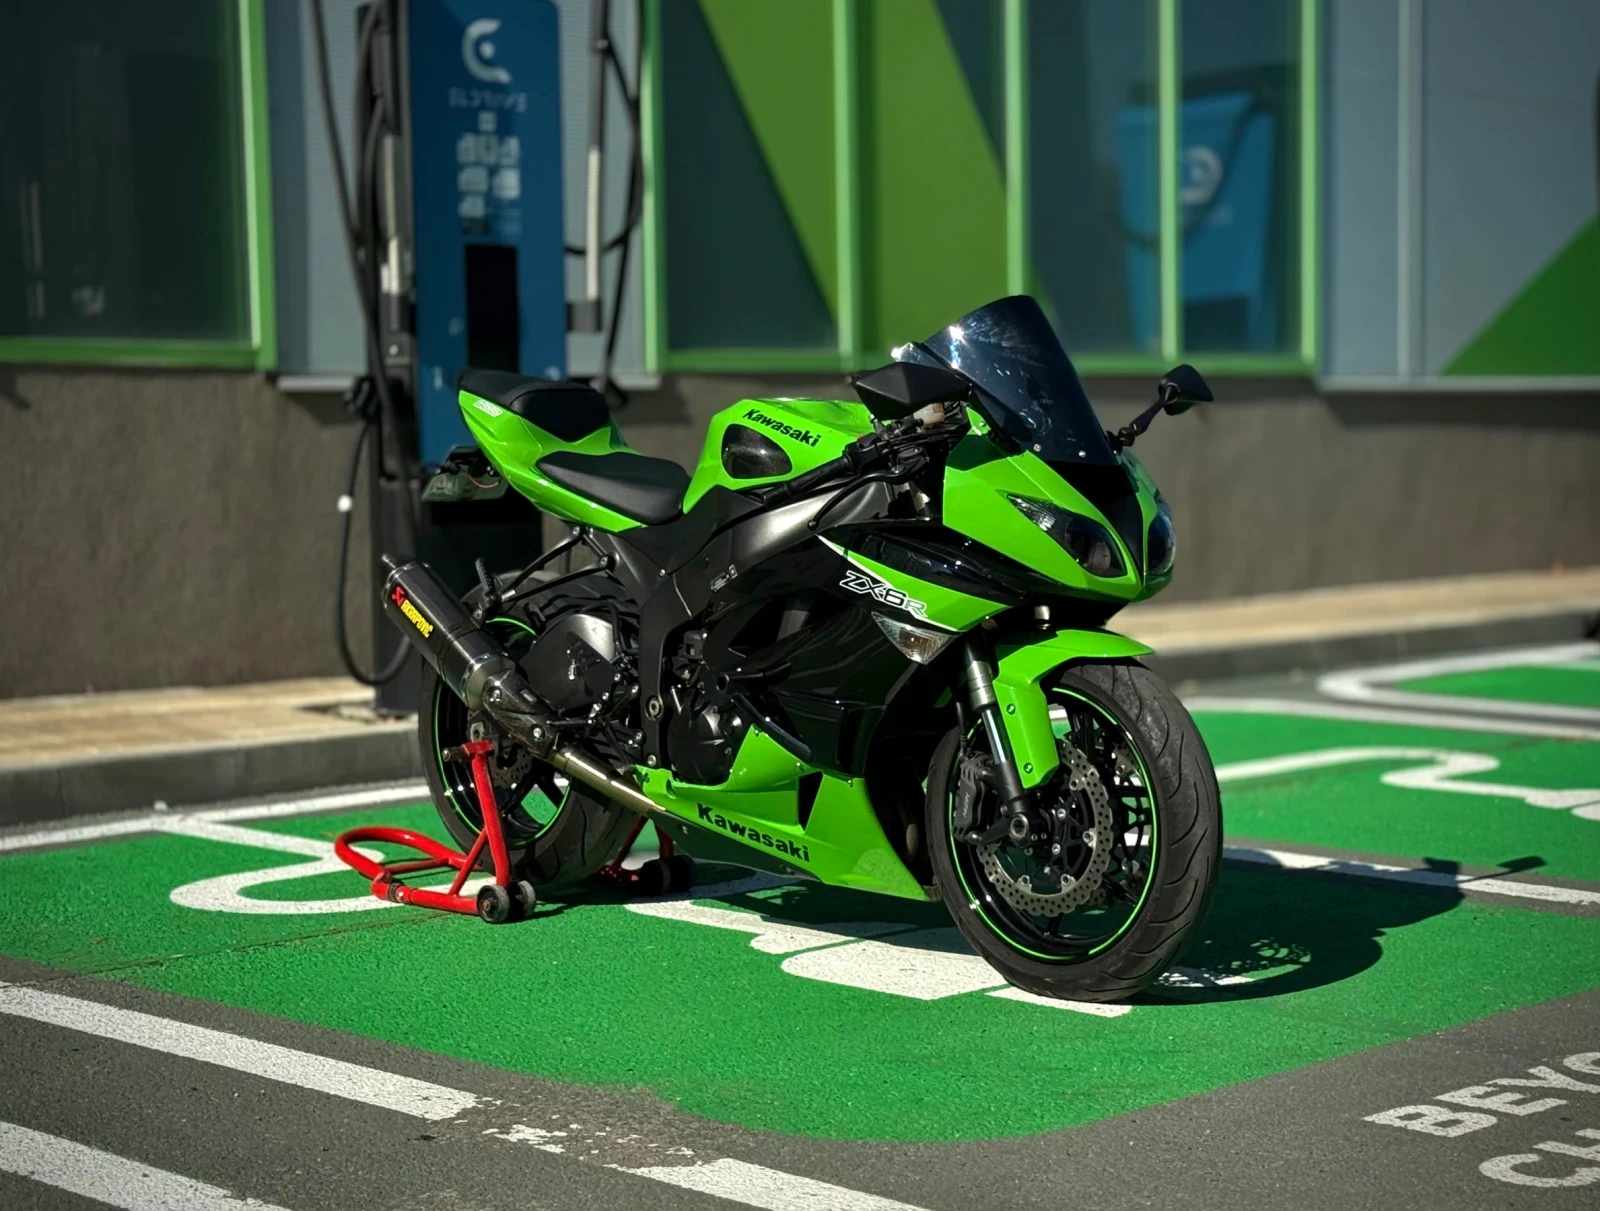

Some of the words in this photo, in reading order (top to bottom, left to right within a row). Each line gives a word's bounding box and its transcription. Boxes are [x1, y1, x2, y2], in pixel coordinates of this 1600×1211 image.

[742, 408, 822, 448] Kawasaki
[839, 569, 928, 618] ZX-6R
[696, 802, 811, 863] Kawasaki
[1361, 1051, 1600, 1138] BEY
